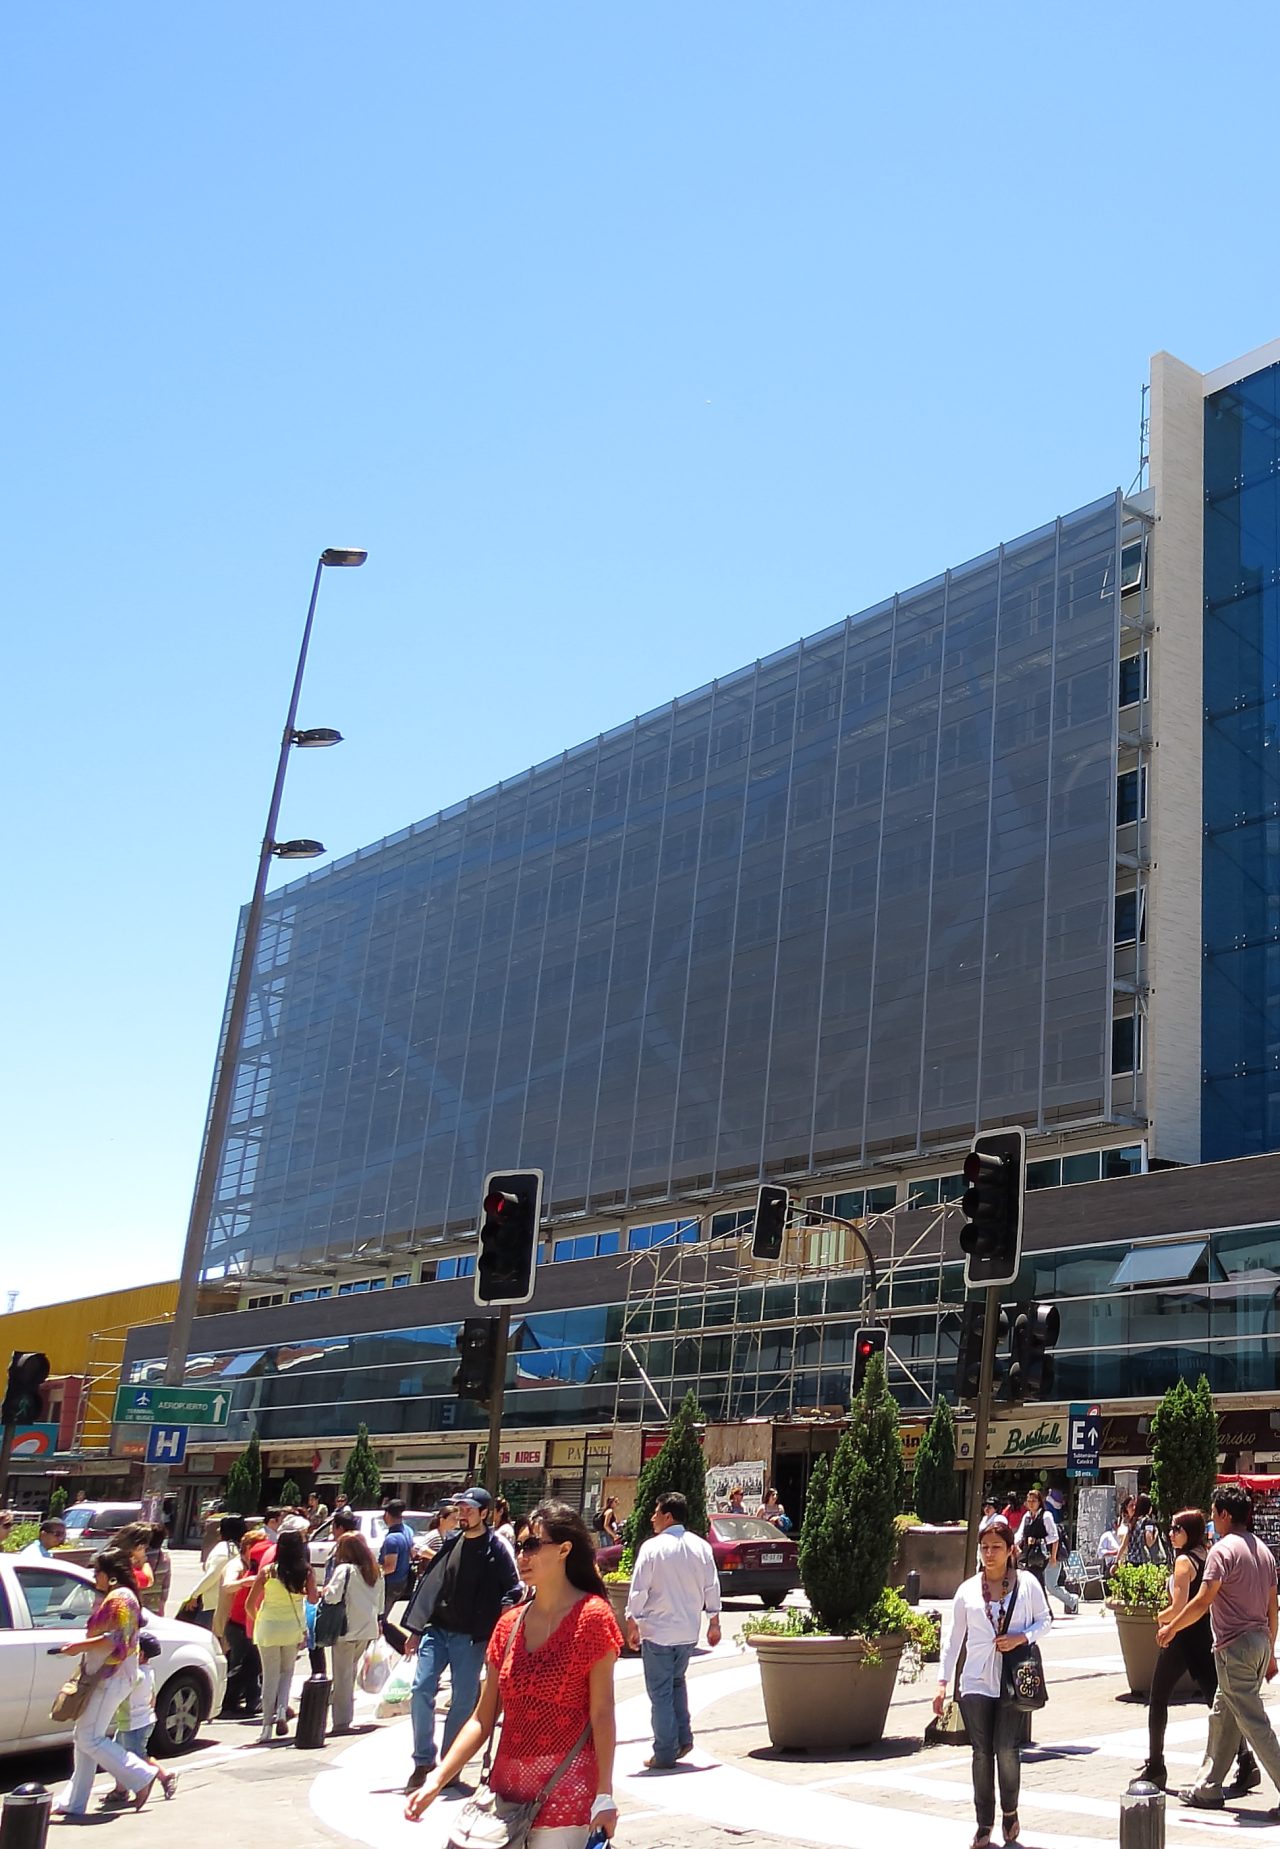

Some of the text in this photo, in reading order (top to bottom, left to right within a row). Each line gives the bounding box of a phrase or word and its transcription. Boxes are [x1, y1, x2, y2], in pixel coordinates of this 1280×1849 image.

[158, 1401, 209, 1411] AEROPUERTO
[155, 1430, 180, 1457] H
[1072, 1421, 1086, 1450] E
[514, 1451, 541, 1463] AIRES
